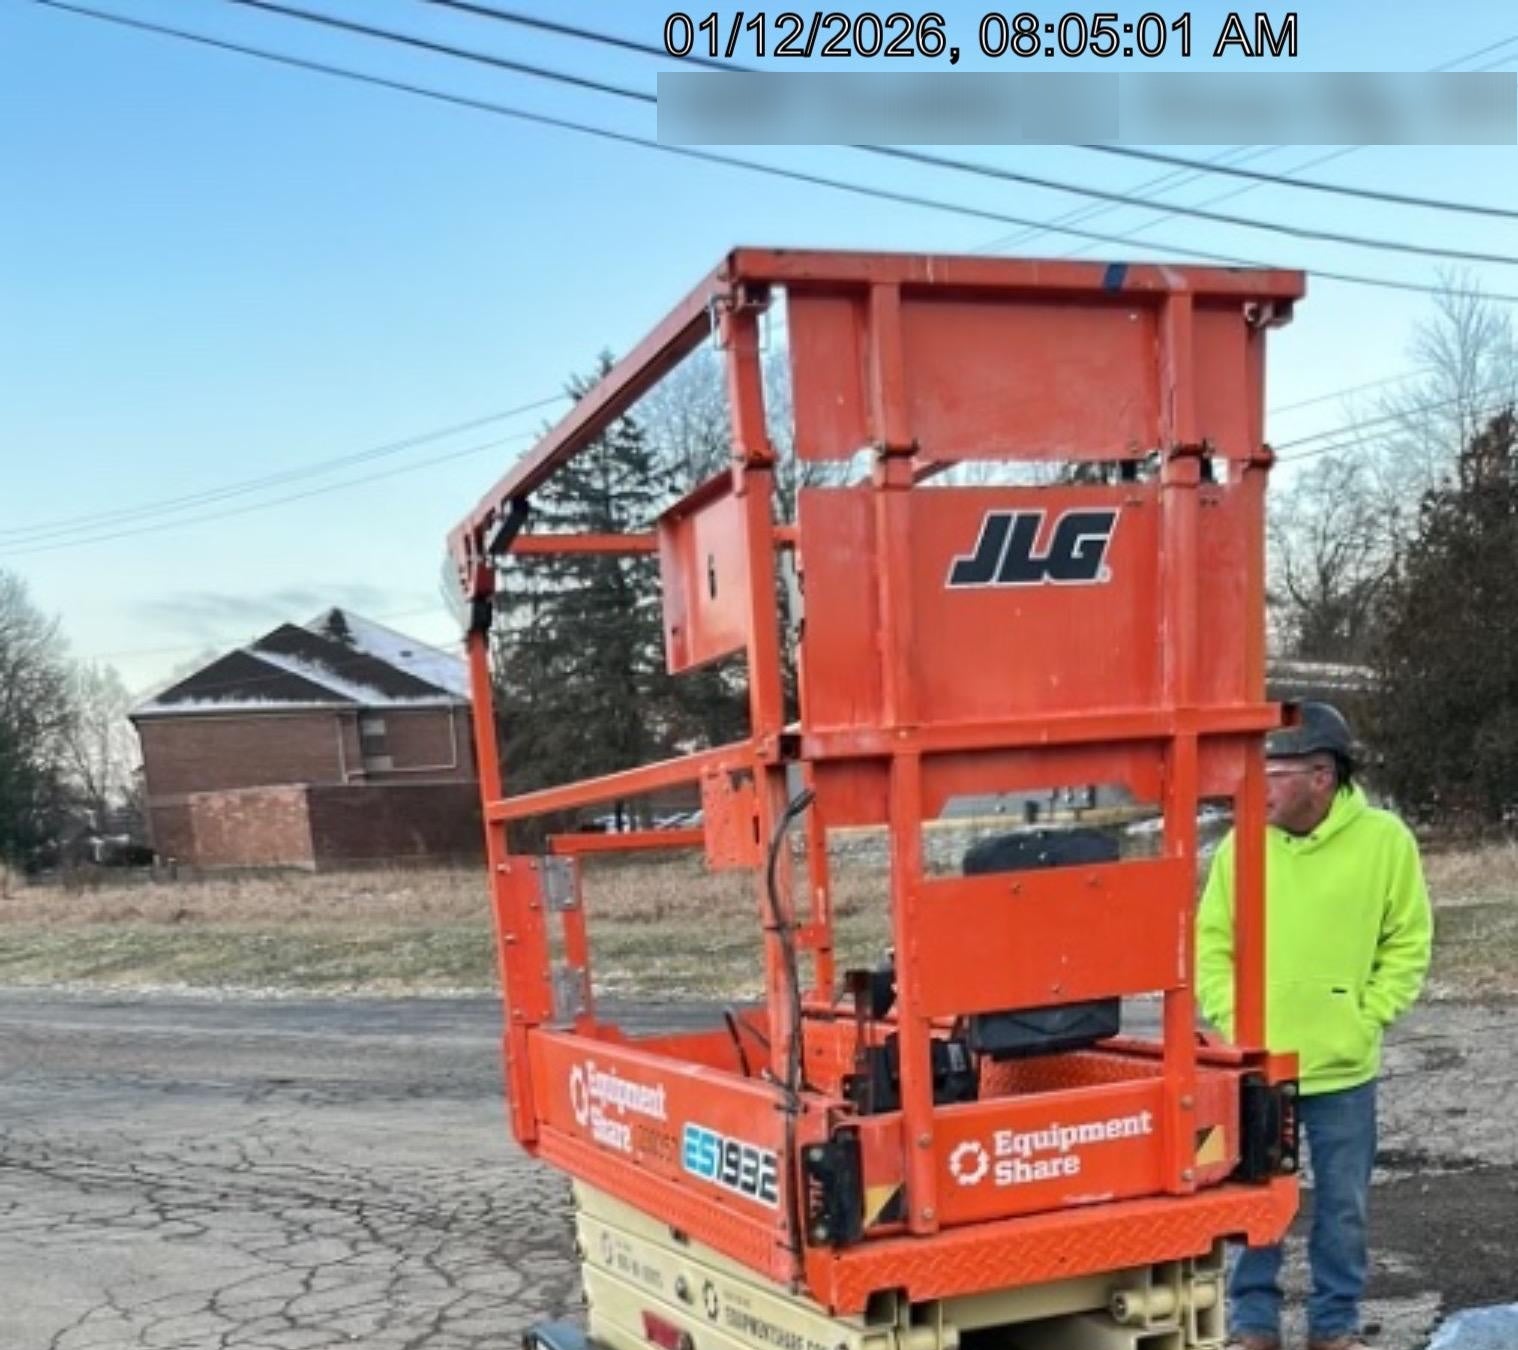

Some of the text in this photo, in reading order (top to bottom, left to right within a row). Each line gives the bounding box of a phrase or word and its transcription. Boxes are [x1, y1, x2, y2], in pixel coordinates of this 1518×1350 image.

[945, 507, 1121, 589] JLG
[586, 1061, 668, 1121] Equipment
[589, 1104, 633, 1154] Share
[992, 1109, 1153, 1157] Equipment
[683, 1122, 779, 1208] ES1932
[994, 1153, 1081, 1187] Share
